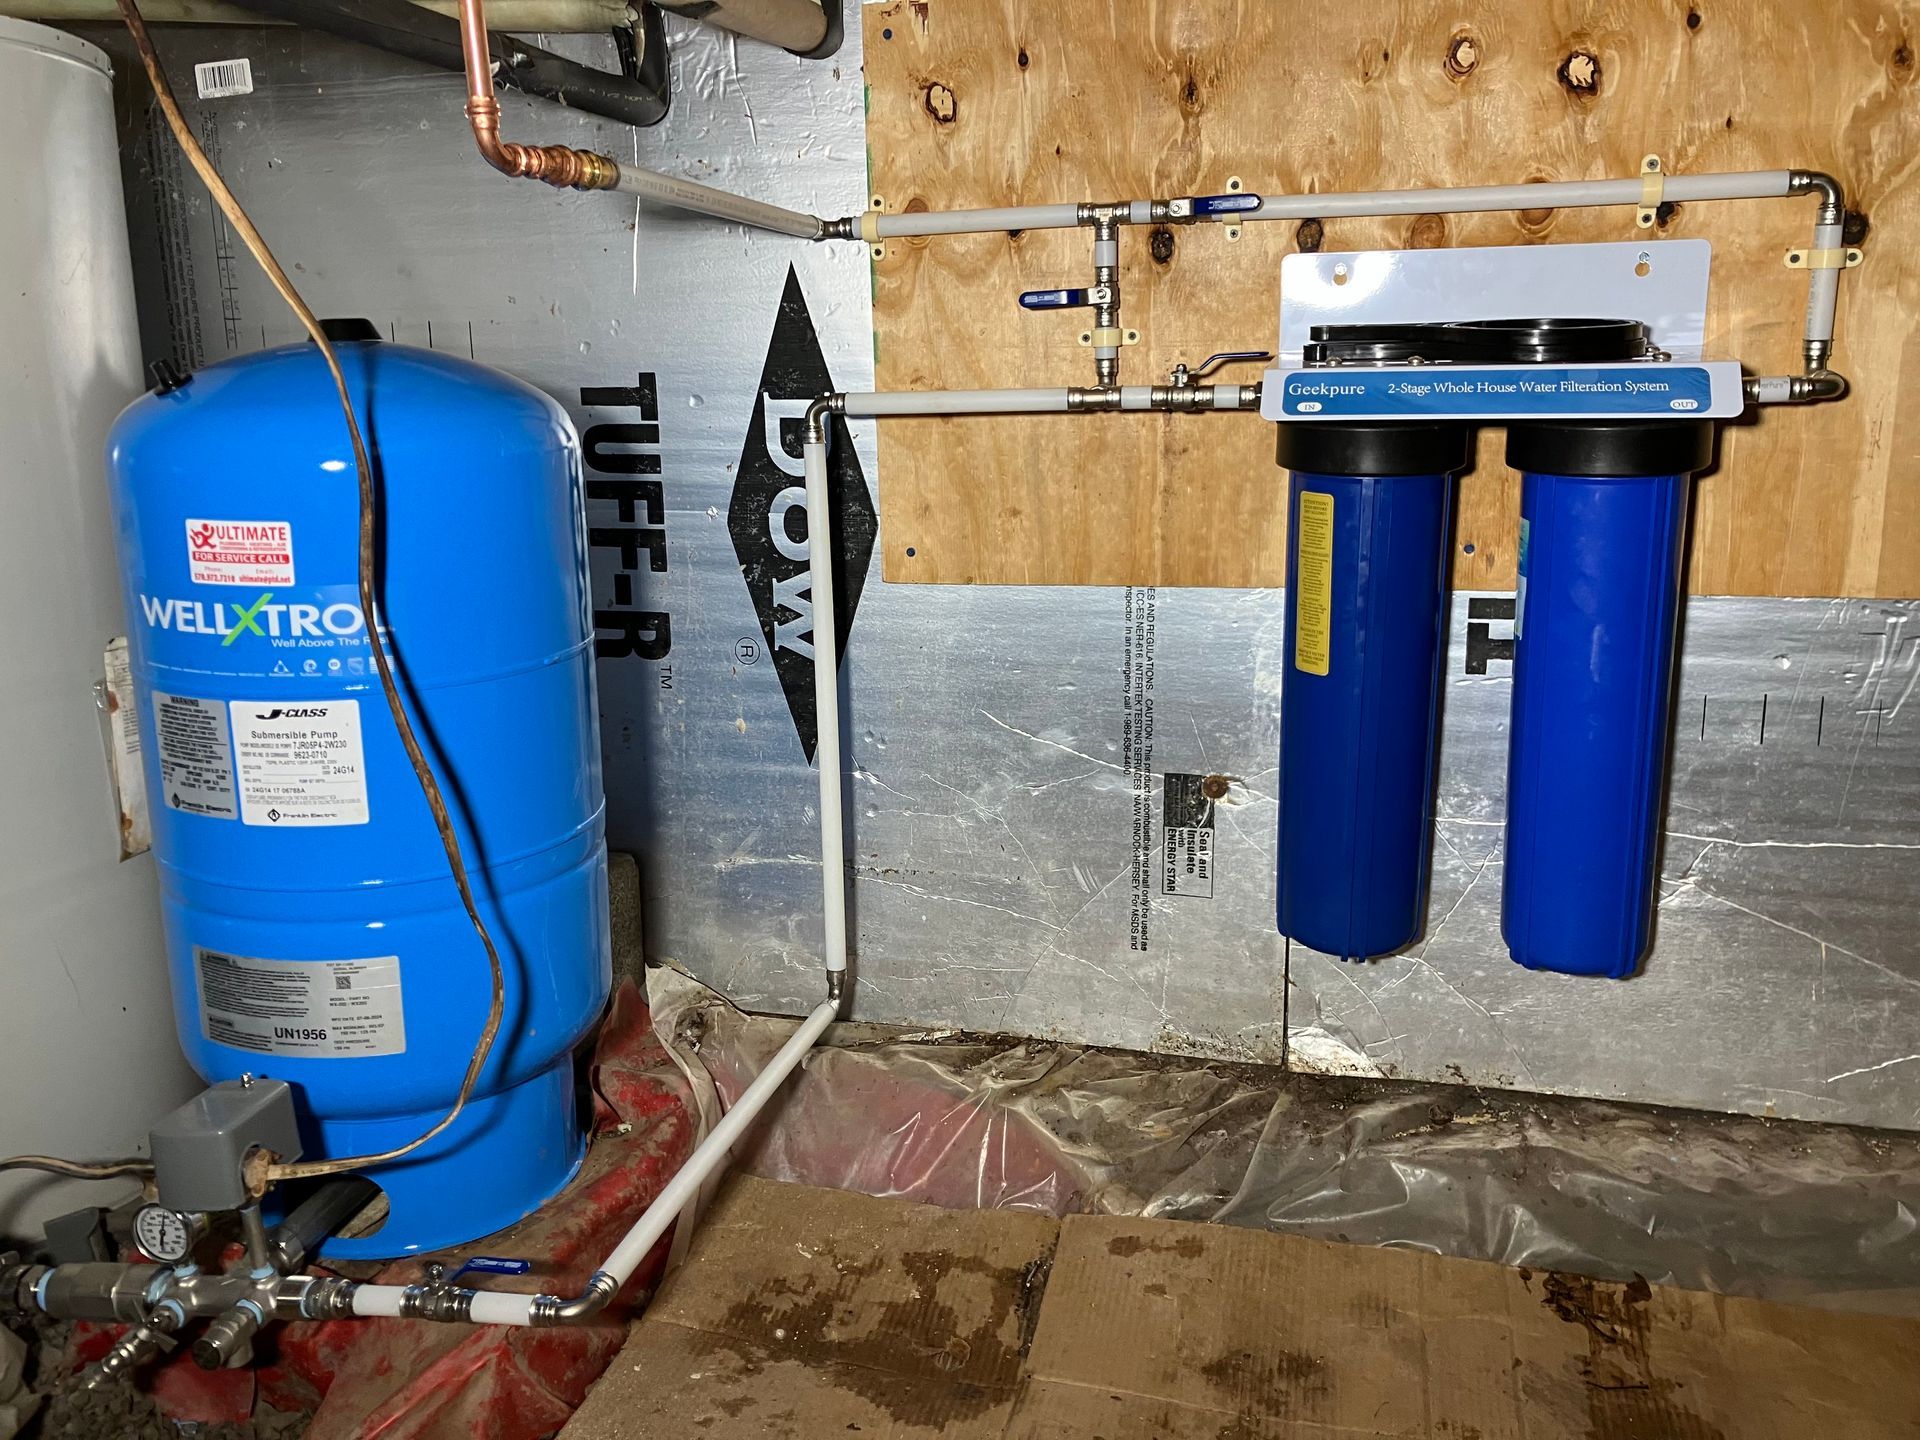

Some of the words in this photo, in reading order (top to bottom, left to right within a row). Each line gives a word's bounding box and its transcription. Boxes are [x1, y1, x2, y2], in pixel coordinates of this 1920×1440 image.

[186, 265, 194, 276] TO
[188, 278, 199, 314] ENSURE
[193, 316, 204, 358] PRODUCT
[1289, 383, 1366, 398] Geekpure
[1387, 382, 1431, 396] 2-Stage
[1433, 381, 1474, 393] Whole
[1476, 382, 1517, 393] House
[1519, 381, 1557, 393] Water
[1560, 381, 1622, 392] Filteration
[1625, 380, 1669, 394] System
[216, 525, 287, 541] ULTIMATE
[580, 372, 672, 661] TUFF-R
[660, 665, 673, 689] TM
[763, 391, 831, 660] DOW
[195, 552, 214, 561] FOR
[215, 552, 256, 563] SERVICE
[258, 554, 286, 563] CALL
[1146, 602, 1155, 622] AND
[1125, 626, 1133, 634] In
[271, 638, 296, 648] Well
[298, 637, 334, 648] Above
[338, 637, 360, 646] The
[1125, 636, 1131, 647] an
[1145, 624, 1154, 692] REGULATIONS.
[1122, 649, 1132, 696] emergency
[1134, 662, 1143, 706] INTERTEK
[1124, 696, 1132, 709] call
[255, 708, 328, 720] J-CLASS
[1144, 698, 1153, 741] CAUTION:
[251, 730, 307, 739] Submersible
[311, 730, 338, 739] Pump
[1134, 708, 1142, 745] TESTING
[294, 751, 328, 759] 9623-0710
[1144, 744, 1153, 761] This
[333, 766, 355, 775] 24G14
[1133, 747, 1142, 790] SERVICES
[1142, 763, 1151, 793] product
[1142, 803, 1151, 851] combustible
[1167, 829, 1177, 866] ENERGY
[1178, 830, 1186, 848] with
[1199, 831, 1210, 856] Seal
[1142, 852, 1150, 868] and
[1186, 830, 1197, 874] Insulate
[1198, 859, 1209, 879] and
[1142, 870, 1150, 888] shall
[1167, 867, 1176, 891] STAR
[1131, 894, 1140, 908] For
[1140, 889, 1150, 907] only
[1131, 908, 1139, 934] MSDS
[1141, 908, 1149, 919] be
[1141, 920, 1149, 940] used
[1130, 935, 1139, 950] and
[1140, 941, 1148, 951] as
[274, 1027, 327, 1040] UN1956
